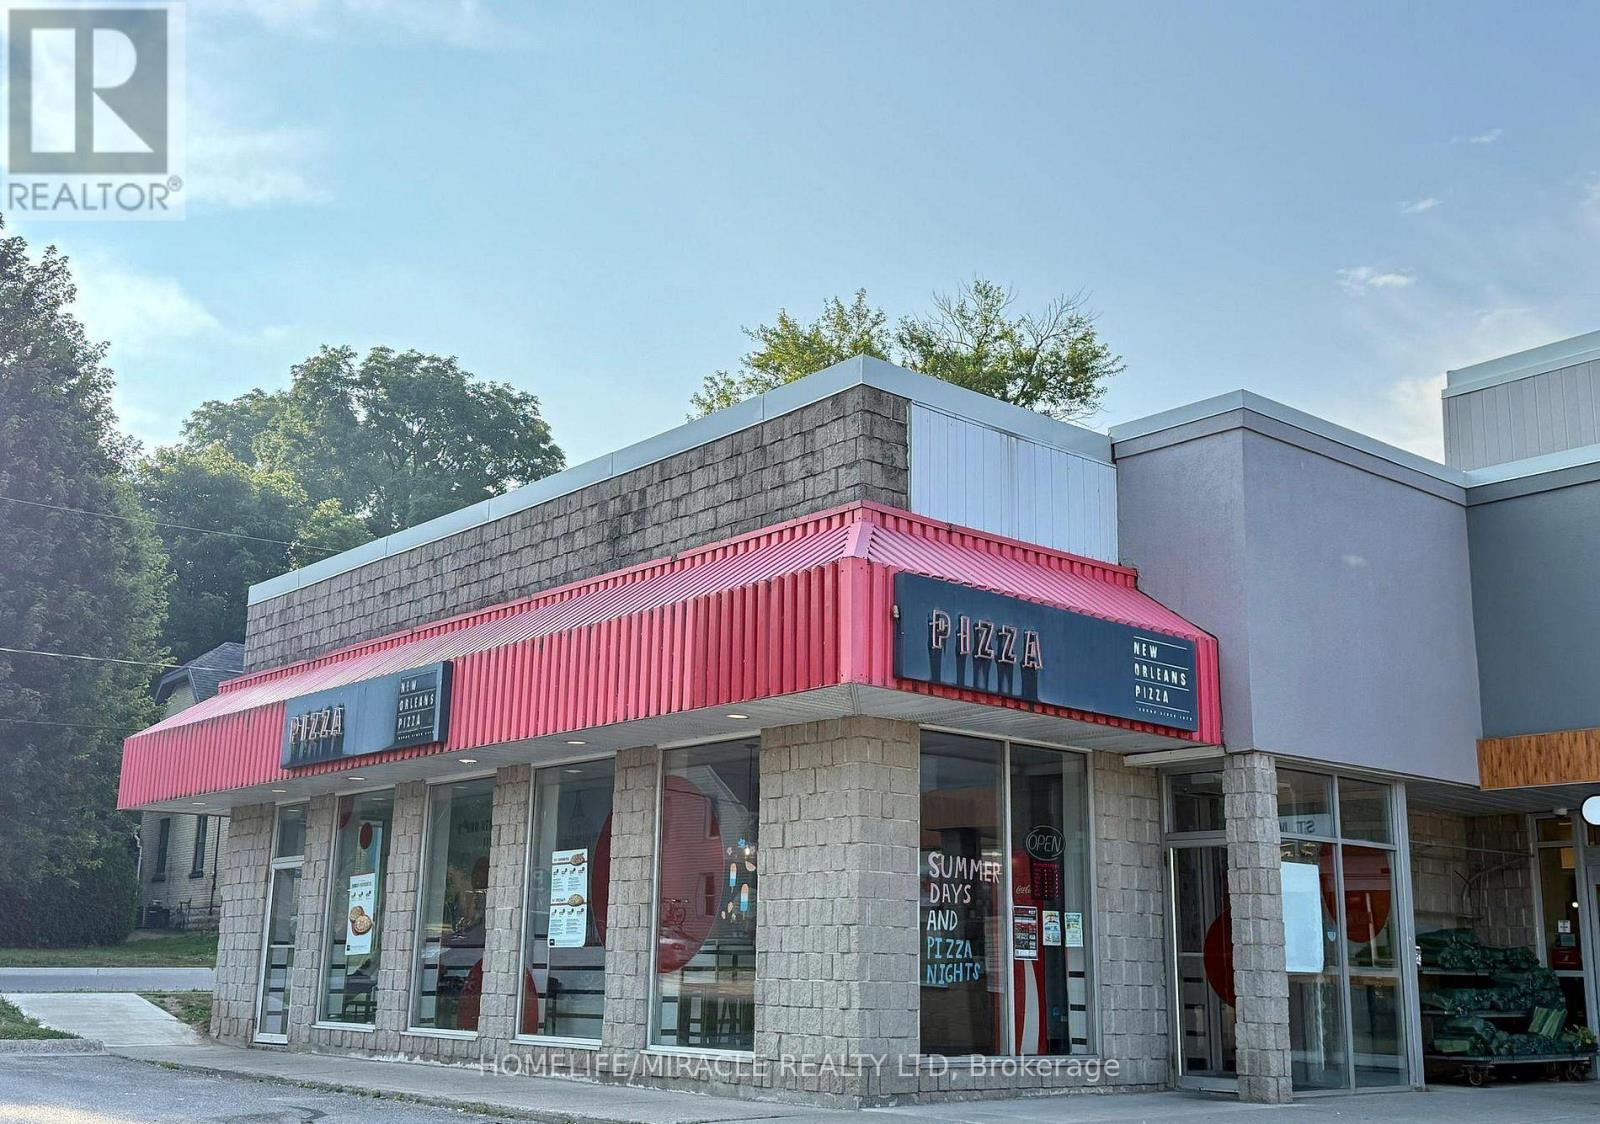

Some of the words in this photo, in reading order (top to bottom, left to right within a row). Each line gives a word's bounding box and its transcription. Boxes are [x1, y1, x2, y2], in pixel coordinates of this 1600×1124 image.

[929, 609, 1043, 670] PIZZA
[1133, 641, 1158, 658] NEW
[1134, 663, 1187, 686] ORLEANS
[401, 680, 417, 693] NEW
[1135, 685, 1169, 703] PIZZA
[399, 693, 435, 711] ORLEANS
[290, 707, 344, 742] PIZZA
[398, 714, 421, 729] PIZZA
[1028, 834, 1062, 852] OPEN
[928, 852, 1001, 884] SUMMER
[929, 883, 972, 904] DAYS
[927, 910, 958, 931] AND
[927, 936, 973, 960] PIZZA
[926, 962, 982, 984] NIGHTS
